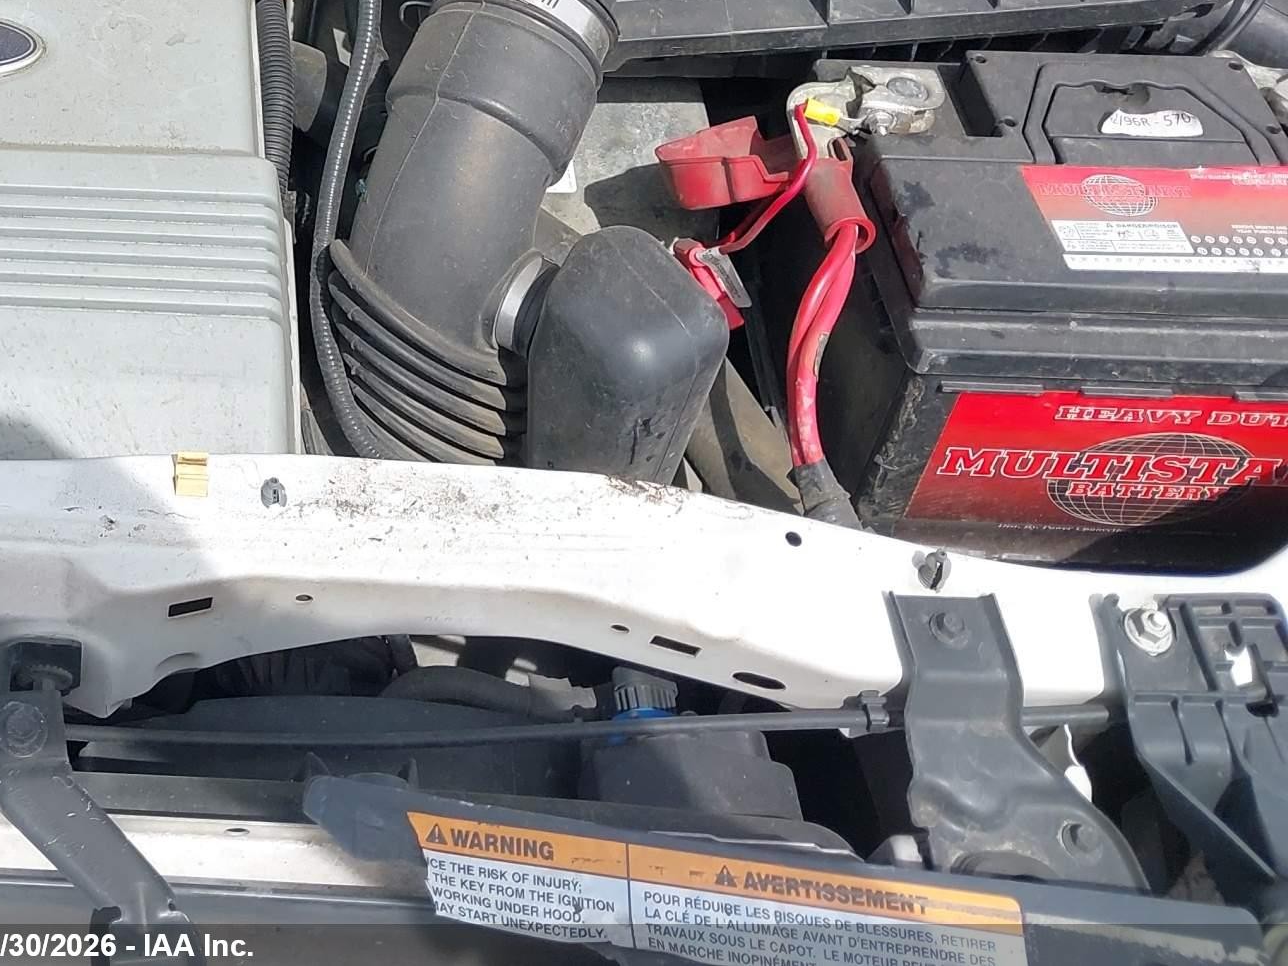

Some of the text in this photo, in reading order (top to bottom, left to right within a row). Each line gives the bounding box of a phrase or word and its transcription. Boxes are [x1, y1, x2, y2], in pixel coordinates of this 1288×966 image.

[1055, 406, 1288, 427] HEAVY DUT
[936, 446, 1288, 486] MULTISTA
[1066, 482, 1231, 502] BATTERY
[450, 828, 554, 861] WARNING
[427, 857, 582, 894] CE THE RISK OF INJURY;
[432, 872, 615, 913] THE KEY FROM THE IGNITION
[743, 870, 929, 914] AVERTISSEMENT
[432, 886, 585, 924] WORKING UNDER HOOD.
[459, 906, 498, 924] START
[501, 914, 608, 939] UNEXPECTEDLY.
[644, 891, 680, 907] POUR
[745, 906, 770, 920] LES
[835, 918, 852, 932] DE
[856, 920, 938, 945] BLESSURES,
[940, 936, 997, 951] RETIRER
[644, 907, 996, 966] LA CLÉ DE L'ALLUMAGE AVANT D'ENTREPRENDRE DES
[646, 924, 899, 966] TRAVAUX SOUS LE CAPOT. LE MOTEUR
[648, 937, 666, 951] EN
[668, 941, 724, 961] MARCHE
